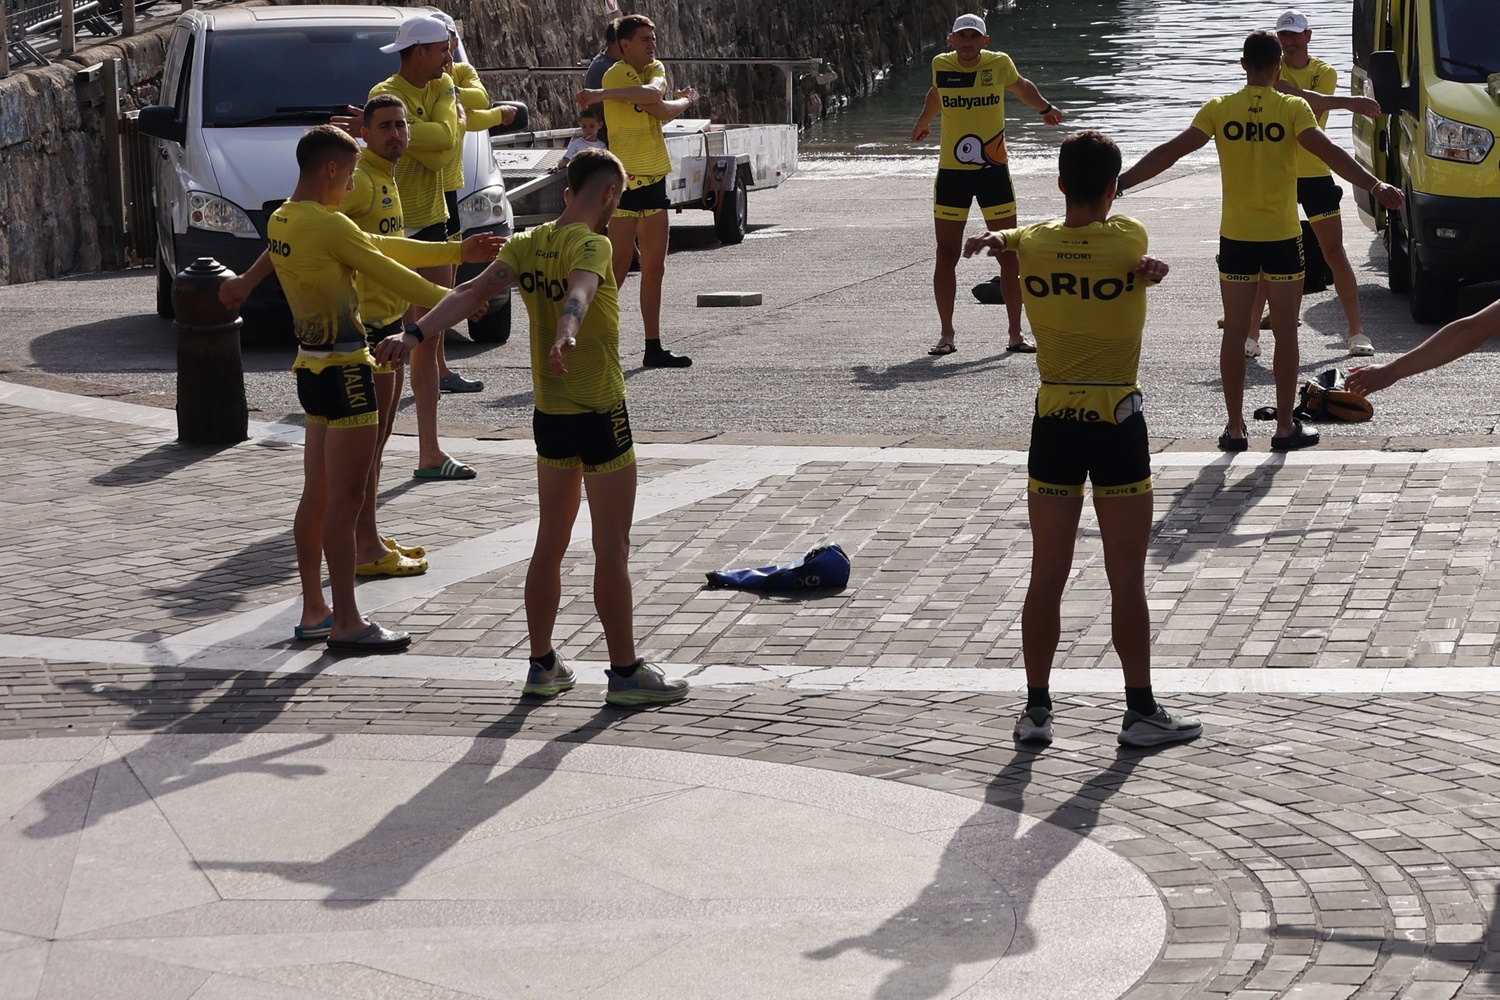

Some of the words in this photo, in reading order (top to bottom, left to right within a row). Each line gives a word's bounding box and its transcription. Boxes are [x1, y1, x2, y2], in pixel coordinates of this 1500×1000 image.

[942, 93, 1000, 109] Babyauto
[1223, 121, 1285, 142] ORIO
[1057, 252, 1091, 260] RODRI
[1025, 271, 1135, 300] ORIO!
